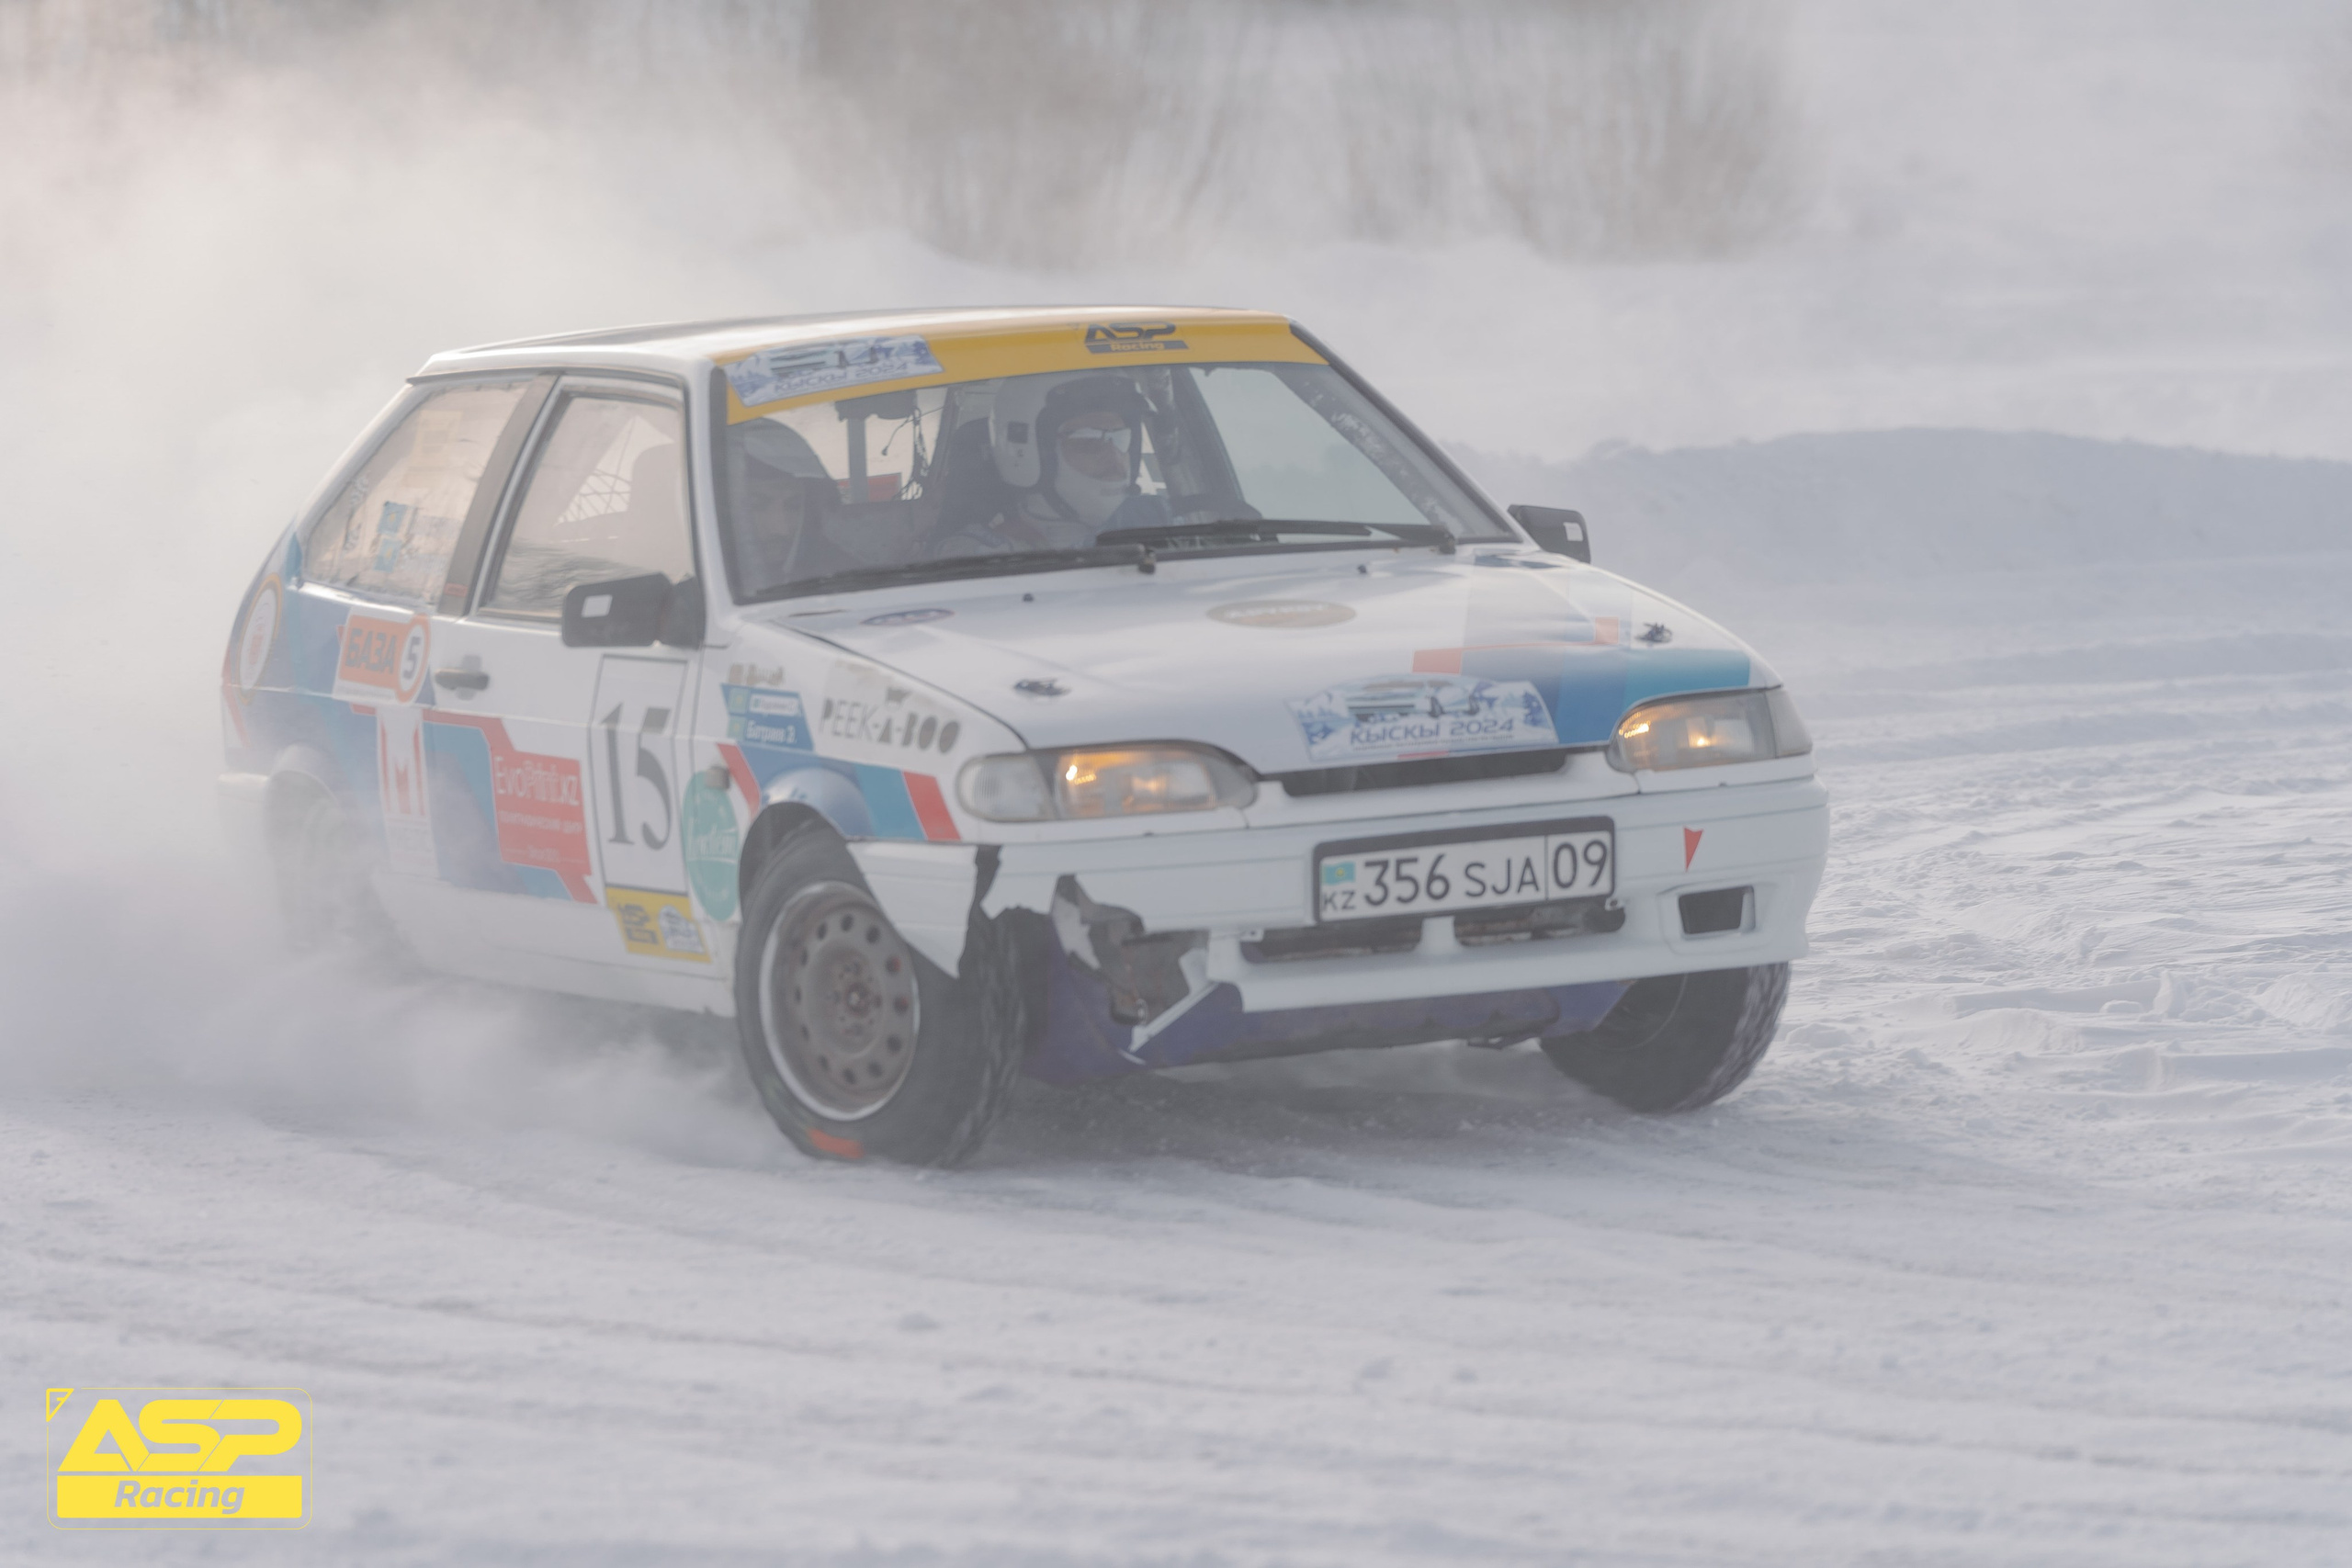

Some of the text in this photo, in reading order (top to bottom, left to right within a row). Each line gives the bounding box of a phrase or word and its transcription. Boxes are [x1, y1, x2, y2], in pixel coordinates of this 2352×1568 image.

[1085, 321, 1176, 343] ASP
[1111, 342, 1165, 352] Racing
[855, 363, 908, 378] 2024
[345, 628, 420, 680] БАЗА 5
[1450, 717, 1514, 736] 2024
[599, 702, 672, 851] 15
[1363, 840, 1609, 908] 356 SJA 09
[1322, 890, 1356, 911] KZ
